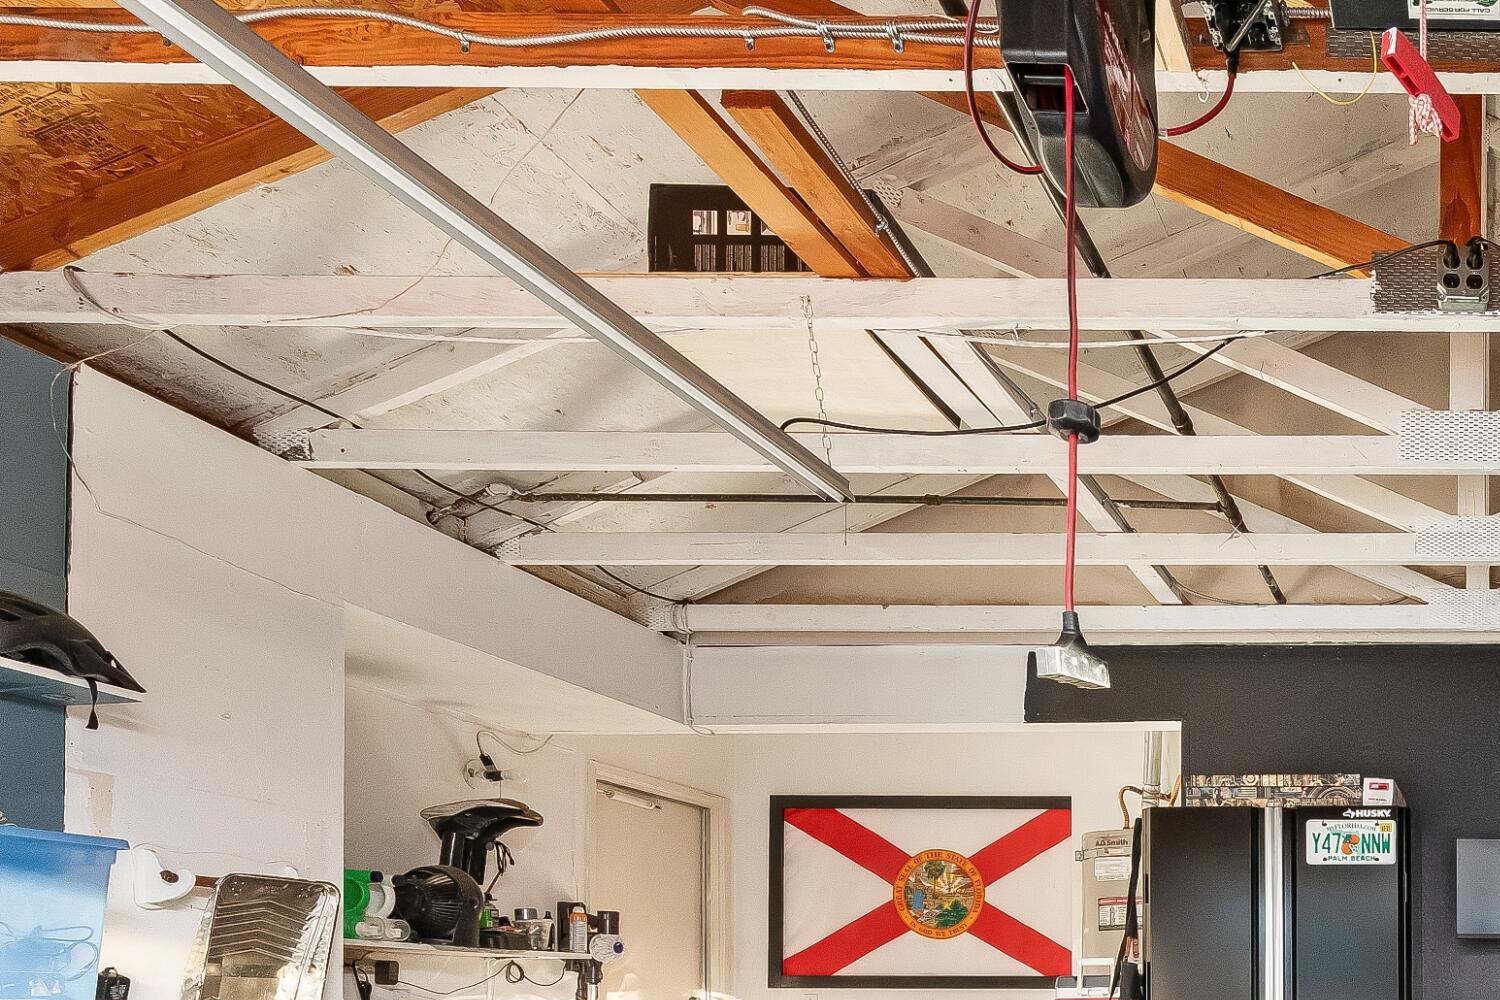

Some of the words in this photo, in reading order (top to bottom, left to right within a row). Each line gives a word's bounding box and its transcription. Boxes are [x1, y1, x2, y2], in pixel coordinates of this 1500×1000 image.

[1356, 809, 1391, 818] HUSKY
[1312, 832, 1341, 853] Y47
[1361, 833, 1391, 854] NNW
[914, 857, 922, 865] OF
[946, 851, 966, 866] STATE
[899, 866, 912, 882] SEAL
[969, 867, 977, 876] OF
[896, 886, 905, 912] GREAT
[973, 879, 983, 913] FLORIDA
[918, 927, 933, 935] GOD
[949, 923, 968, 936] TRUST
